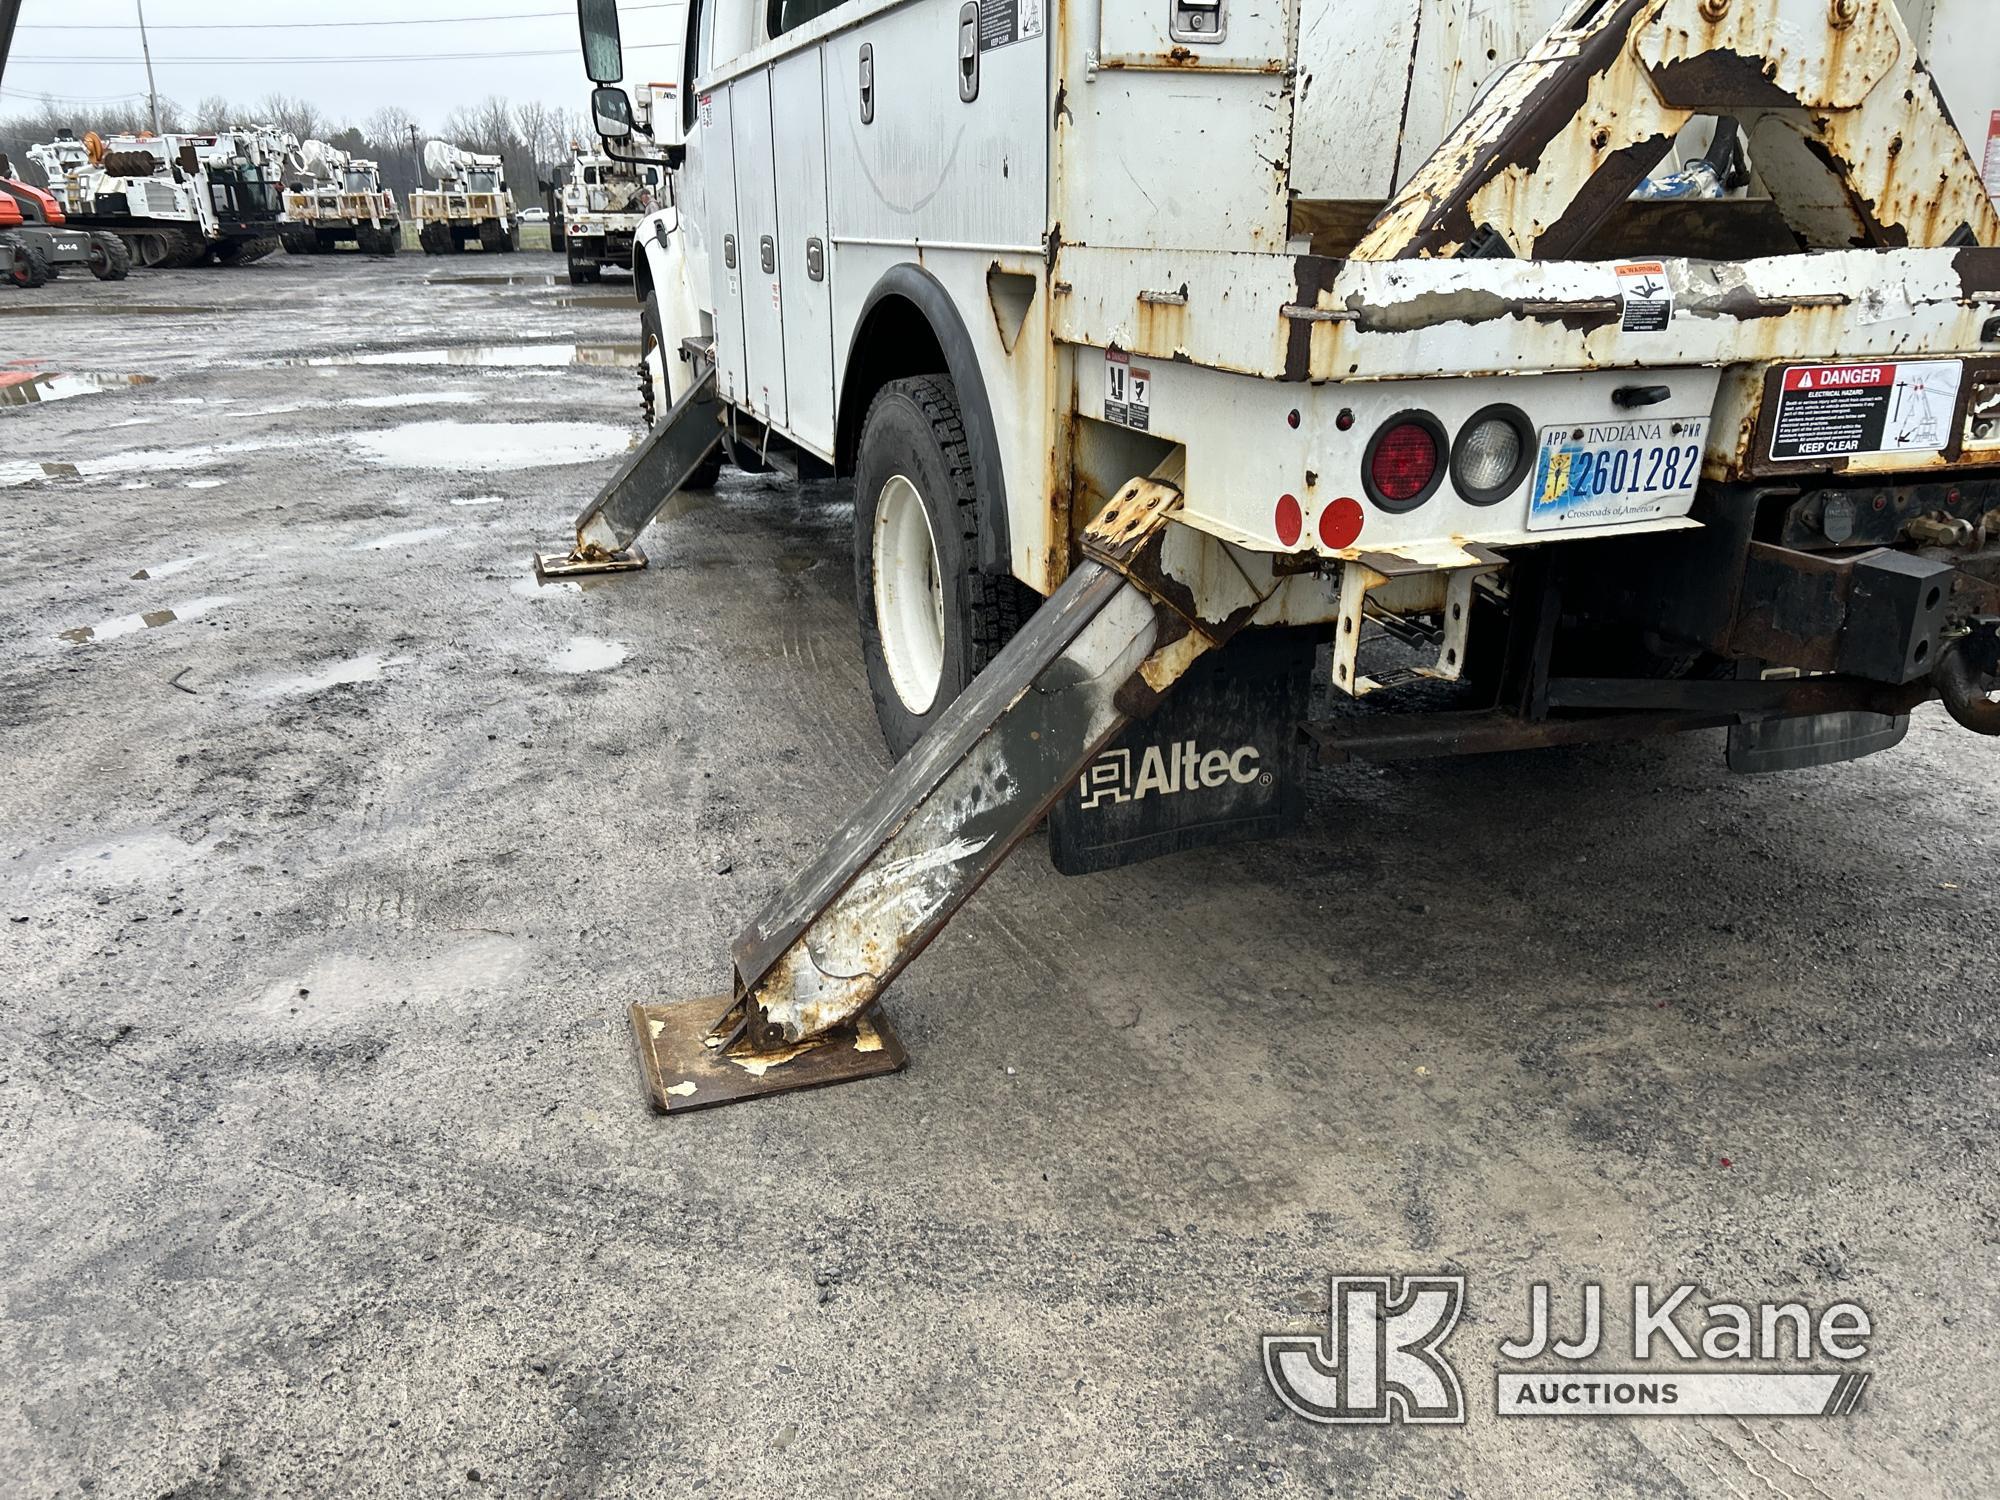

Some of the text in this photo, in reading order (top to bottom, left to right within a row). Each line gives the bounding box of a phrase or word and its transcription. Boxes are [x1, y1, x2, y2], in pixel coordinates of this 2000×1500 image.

[1820, 368, 1881, 386] DANGER
[1546, 424, 1702, 446] APP INDIANA PWR
[1798, 440, 1858, 454] KEEP CLEAR
[1573, 445, 1699, 497] 2601282
[1567, 504, 1654, 520] Crossroads of America
[1134, 740, 1260, 800] Altec
